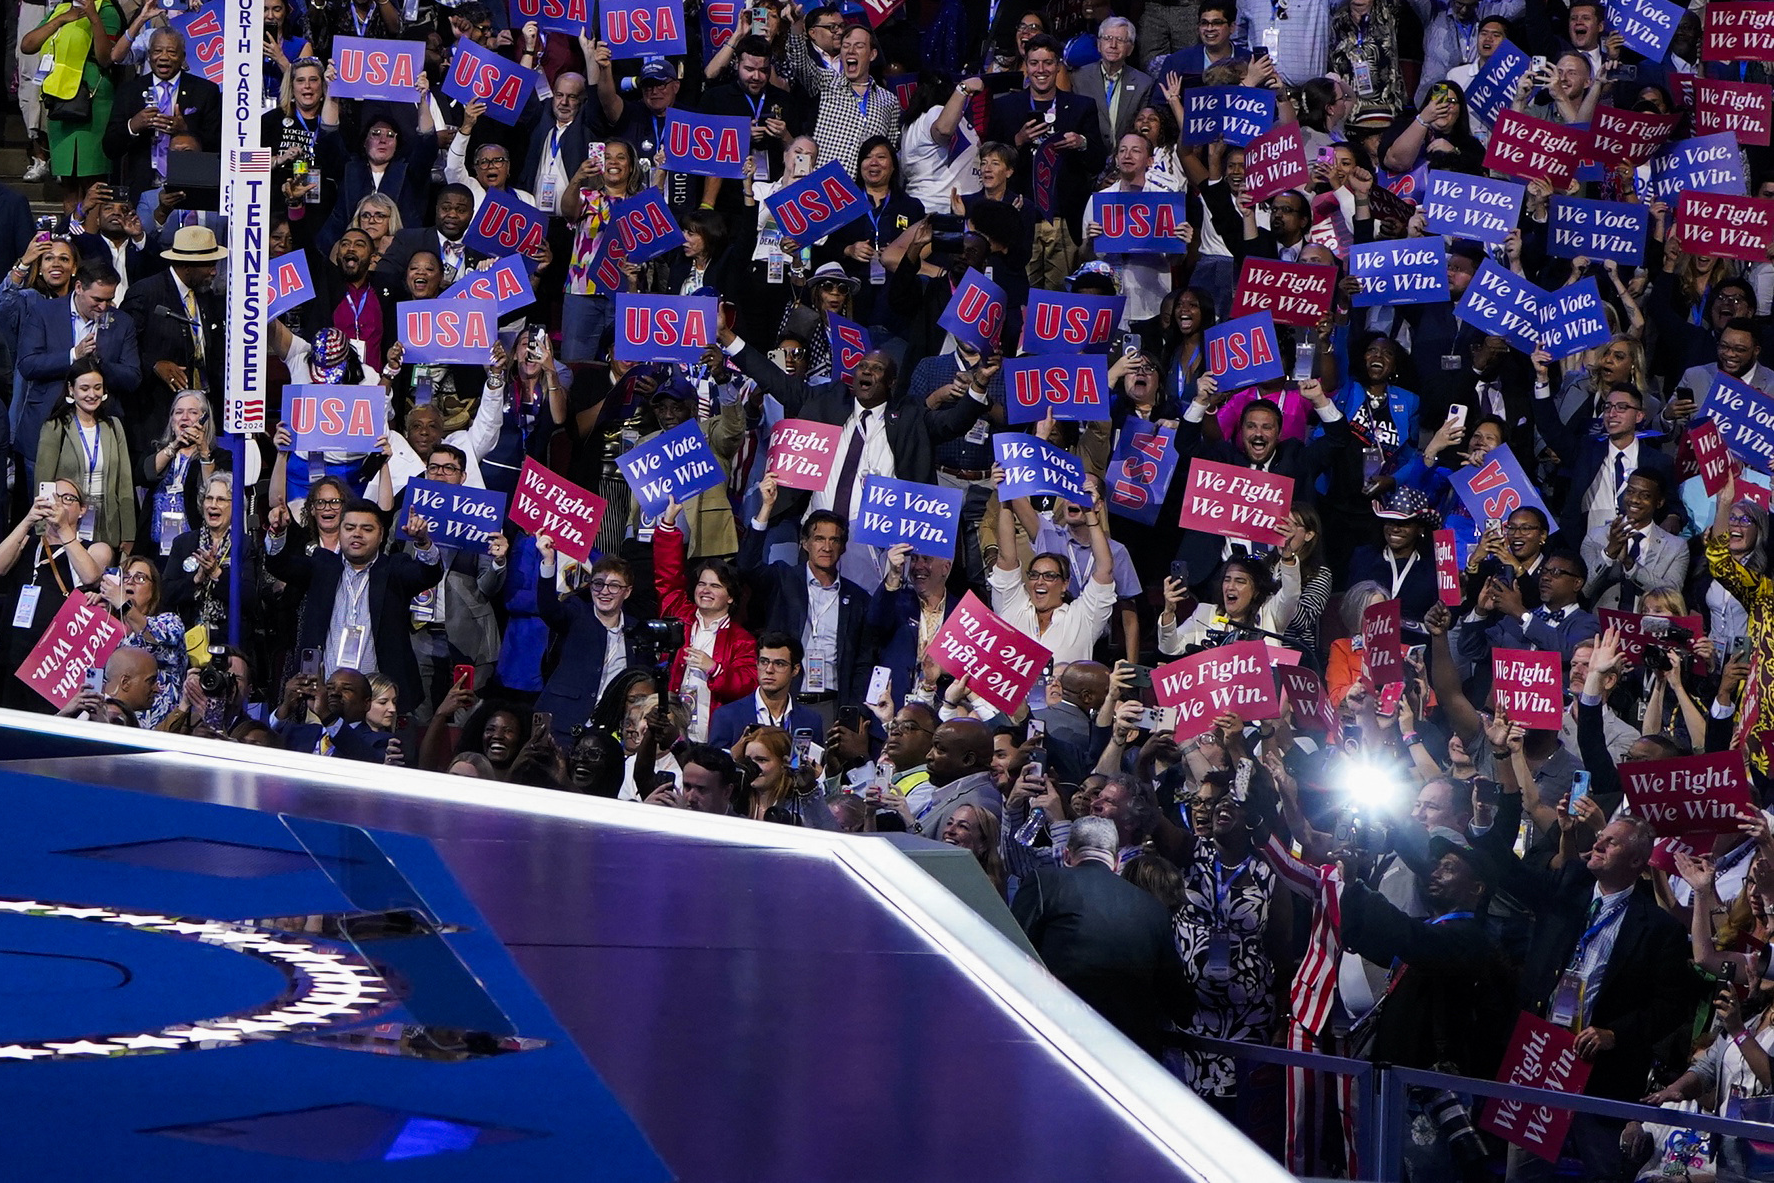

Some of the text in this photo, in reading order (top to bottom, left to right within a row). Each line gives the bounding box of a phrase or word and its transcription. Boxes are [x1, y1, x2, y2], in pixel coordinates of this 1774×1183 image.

[607, 7, 677, 45] USA
[455, 52, 522, 109] USA
[234, 62, 249, 148] CAROLI
[777, 177, 856, 235] USA
[1433, 180, 1463, 198] We
[1470, 185, 1513, 210] Vote,
[1686, 200, 1768, 226] We Fight,
[479, 201, 543, 257] USA
[1102, 205, 1178, 237] USA
[1428, 203, 1508, 232] We Win.
[1558, 205, 1640, 231] We Vote,
[1685, 224, 1766, 249] We Win.
[1556, 229, 1637, 253] We Win.
[242, 180, 262, 392] TENNESSEE
[625, 307, 708, 347] USA
[1209, 327, 1273, 375] USA
[291, 397, 374, 435] USA
[1111, 433, 1166, 508] USA
[1196, 470, 1284, 505] We Fight,
[525, 469, 594, 523] We Fight,
[869, 485, 952, 518] We Vote,
[1192, 496, 1278, 531] We Win.
[518, 493, 584, 546] We Win.
[864, 511, 948, 543] We Win.
[959, 608, 1034, 678] We Win.
[940, 631, 1019, 702] We Fight,
[1161, 655, 1261, 697] We Fight,
[1176, 685, 1268, 725] We Win.
[1630, 766, 1737, 795] We Fight,
[1640, 799, 1740, 822] We Win.
